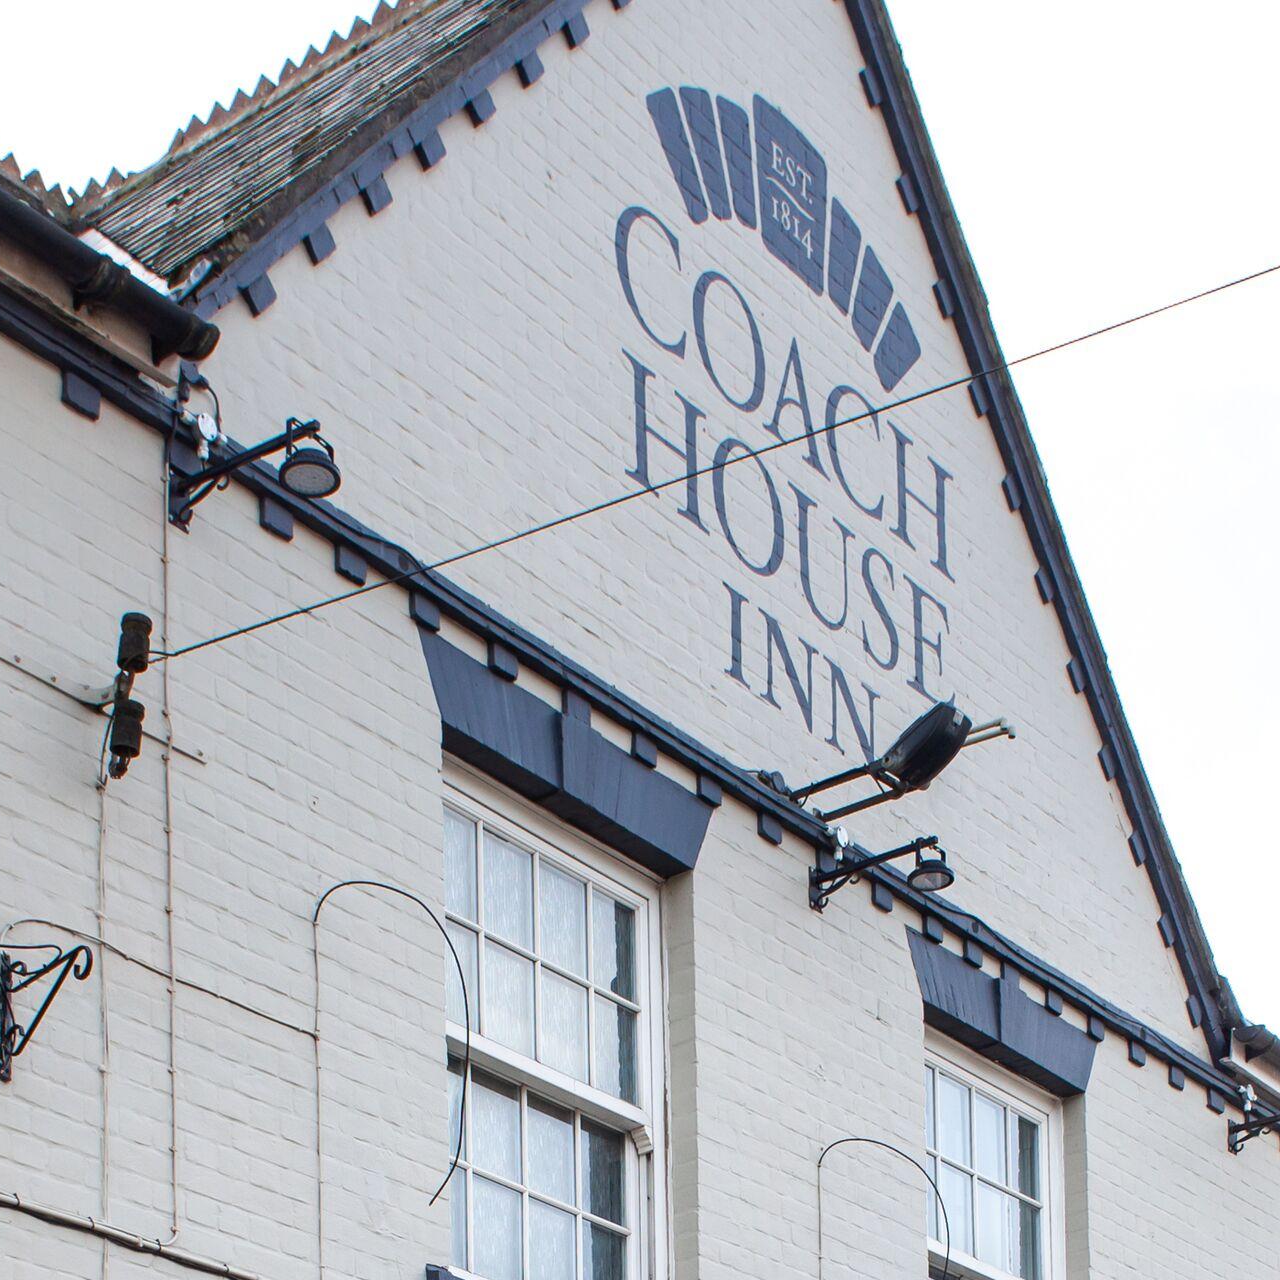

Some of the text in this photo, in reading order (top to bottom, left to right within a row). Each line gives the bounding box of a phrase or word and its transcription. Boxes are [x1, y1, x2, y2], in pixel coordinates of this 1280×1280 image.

[770, 140, 812, 205] EST.
[771, 196, 814, 260] 1814
[615, 205, 956, 584] COACH
[621, 347, 958, 706] HOUSE
[722, 580, 880, 765] INN
